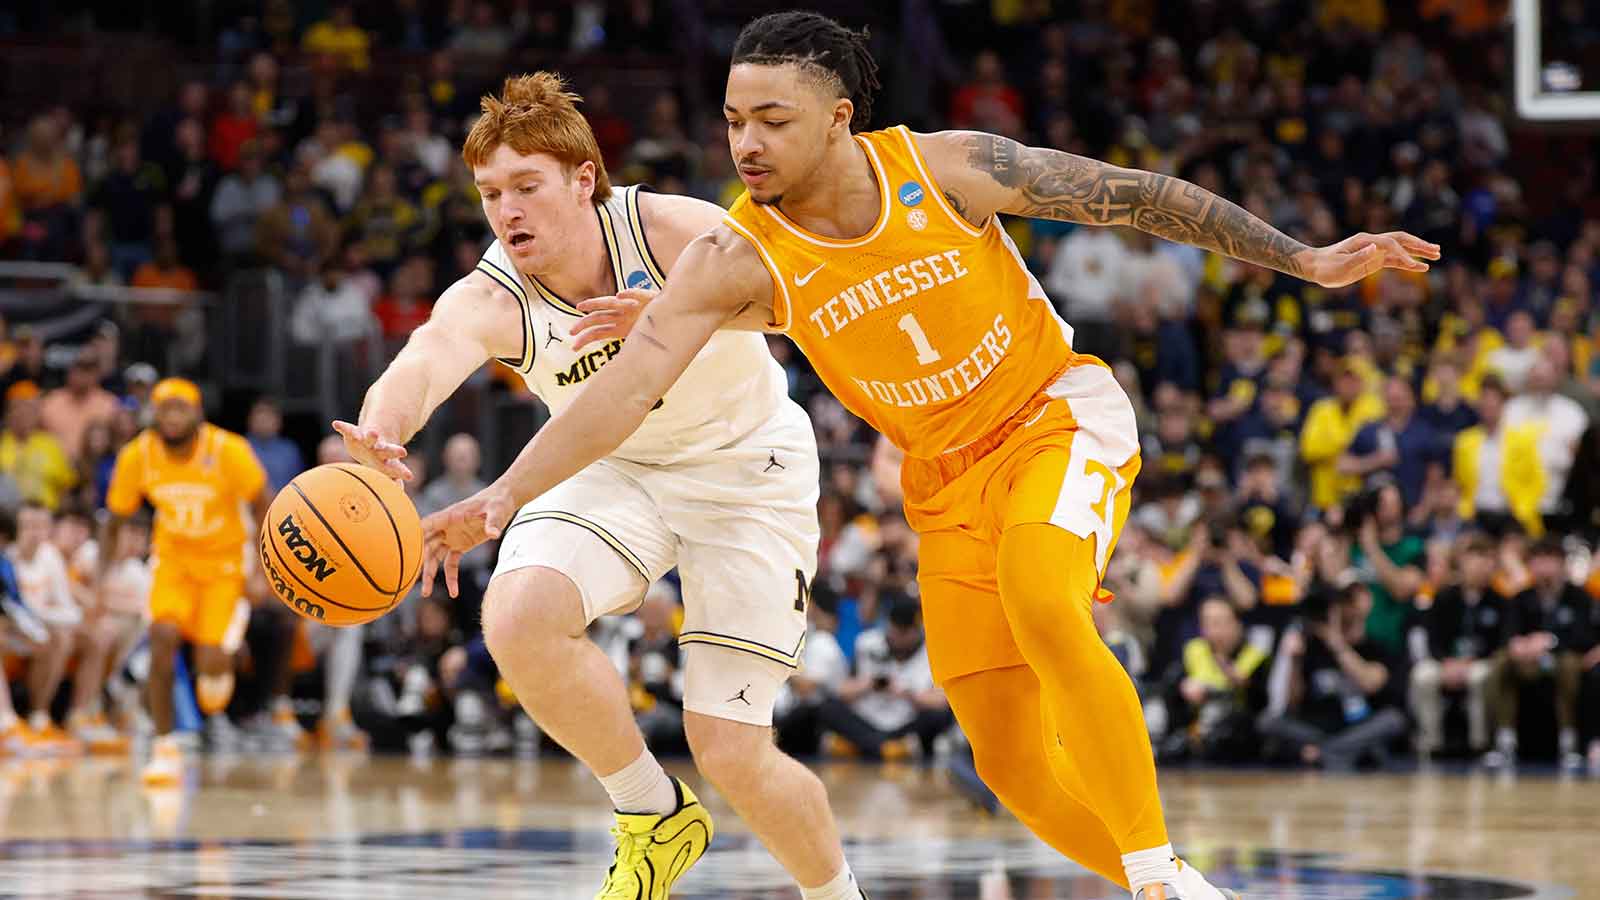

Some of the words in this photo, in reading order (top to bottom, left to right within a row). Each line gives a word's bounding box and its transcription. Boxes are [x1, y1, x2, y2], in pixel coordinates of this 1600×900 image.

[809, 249, 969, 338] TENNESSEE
[555, 338, 627, 386] MICH
[849, 313, 1012, 408] VOLUNTEERS
[897, 313, 942, 365] 1
[278, 513, 336, 583] NCAA
